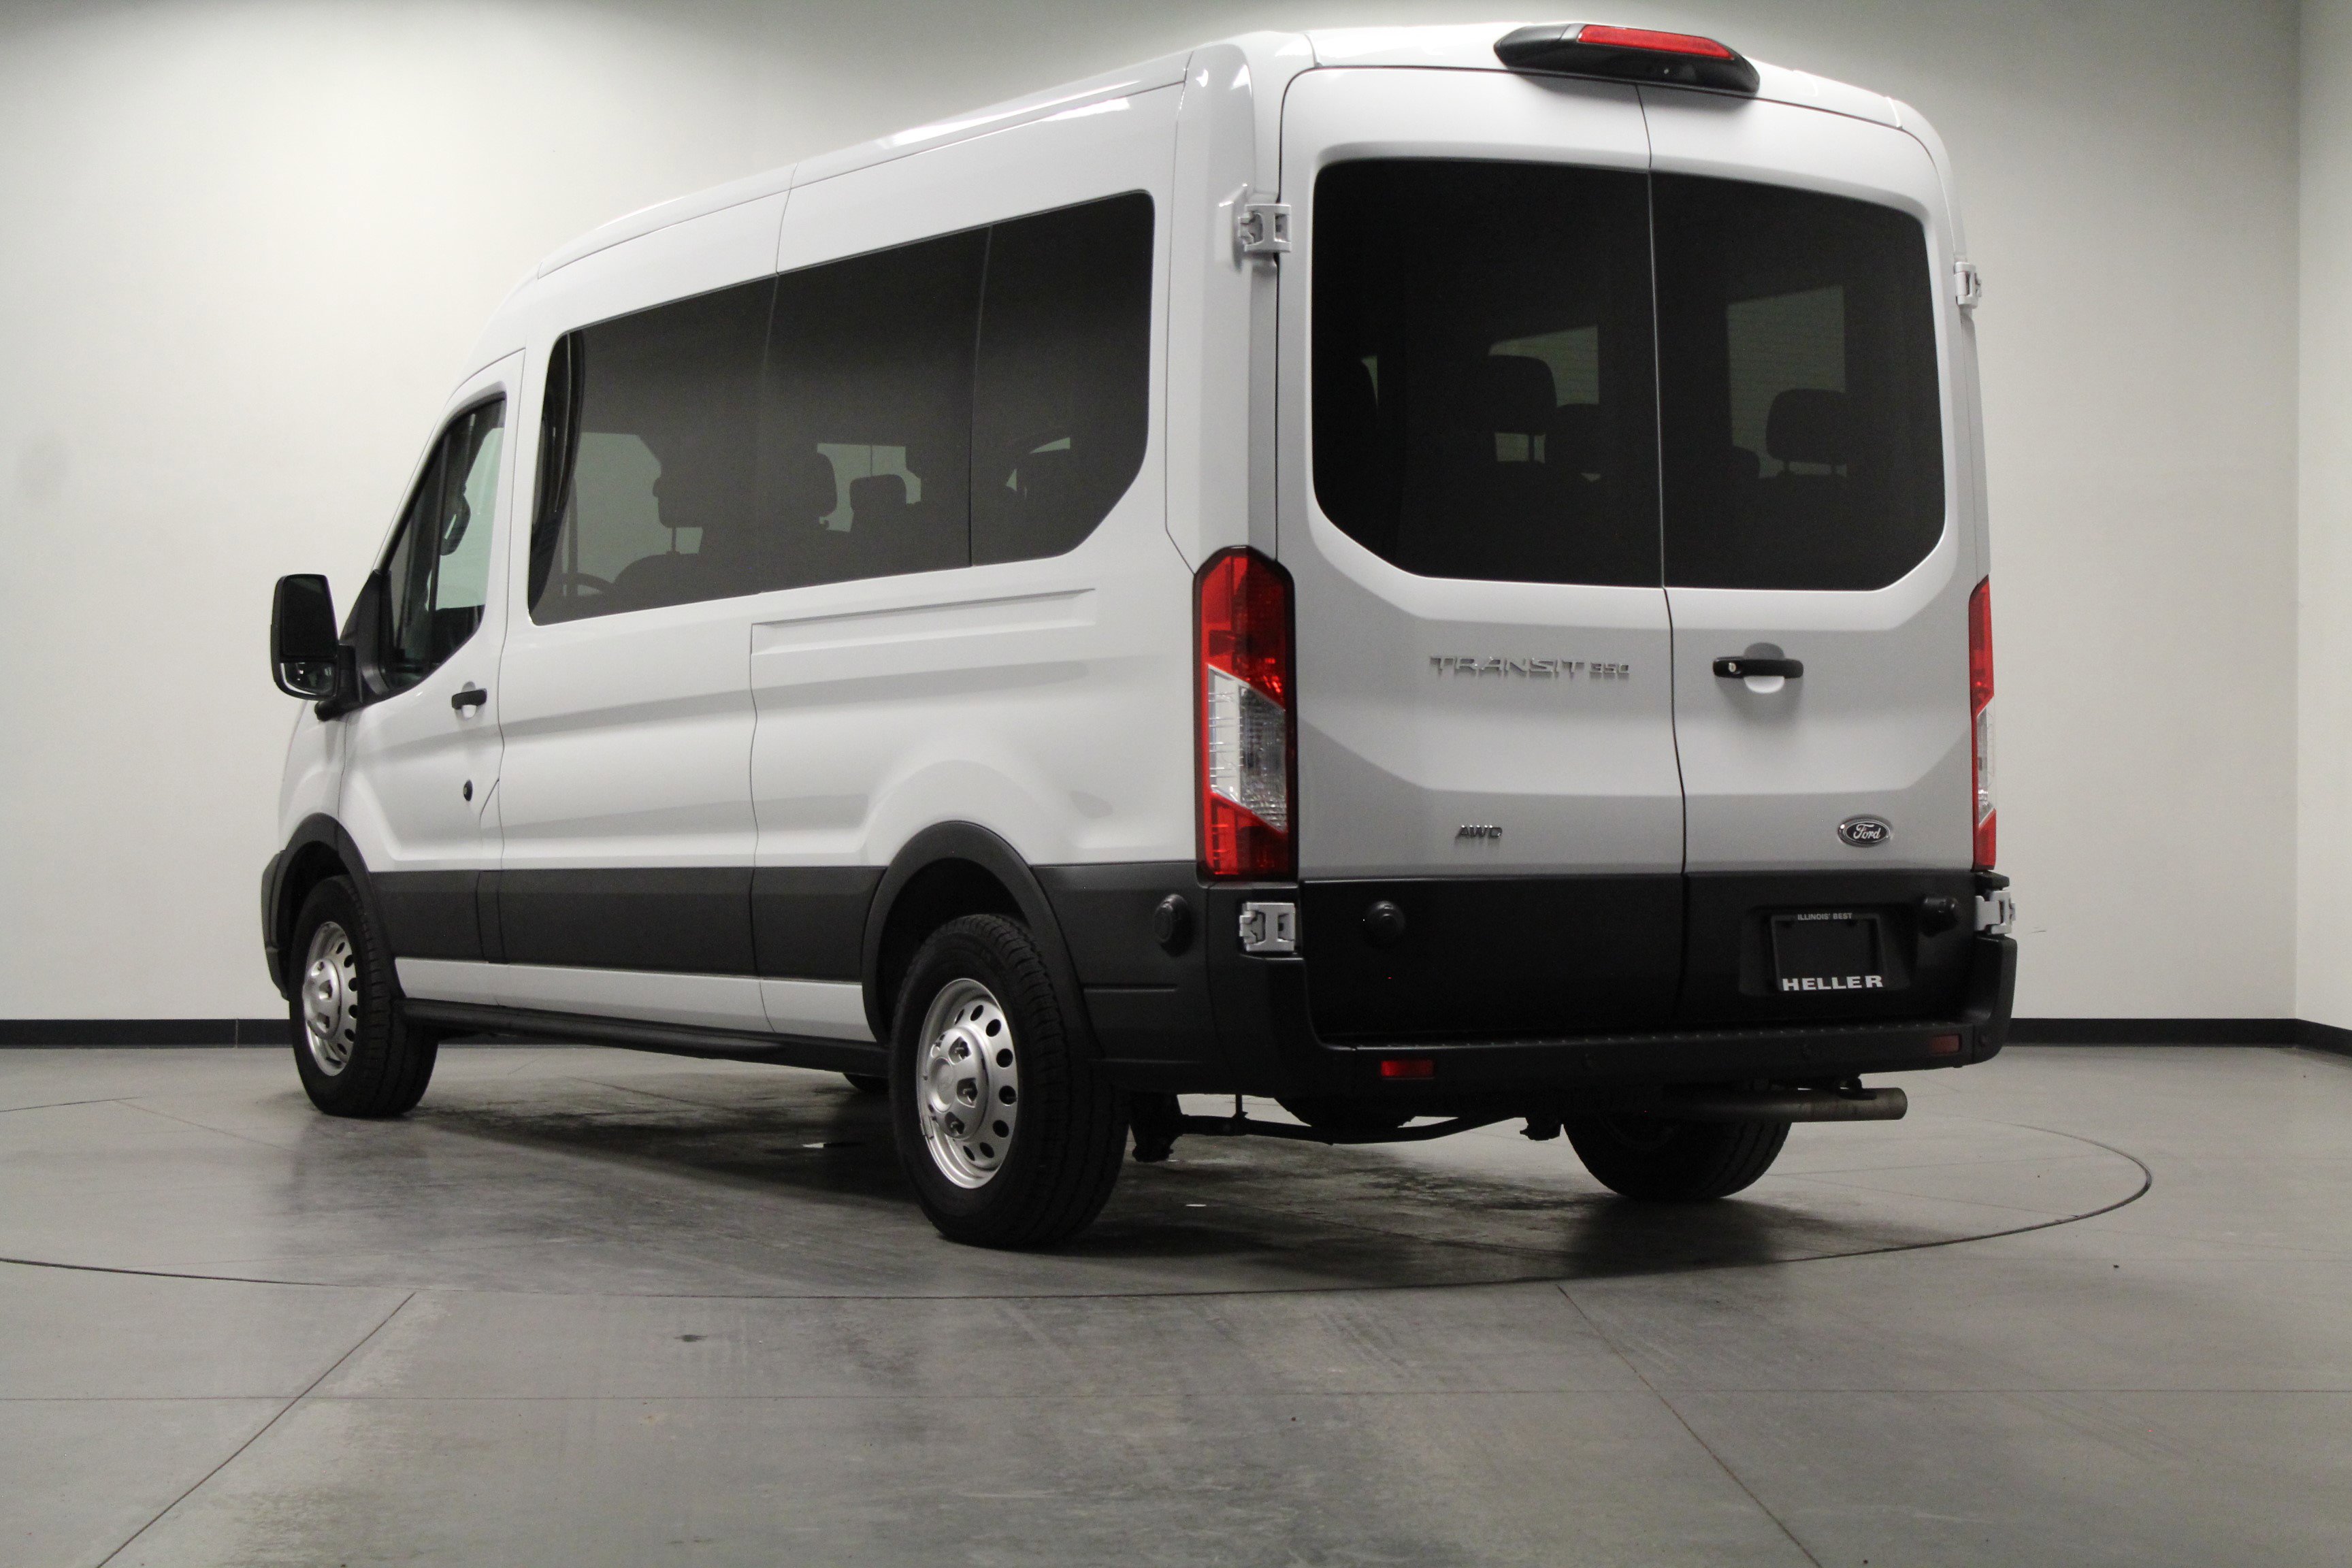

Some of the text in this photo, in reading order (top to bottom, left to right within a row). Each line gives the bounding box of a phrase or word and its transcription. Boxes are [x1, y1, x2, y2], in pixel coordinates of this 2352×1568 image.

[1429, 655, 1630, 678] TRANSIT 350
[1455, 824, 1503, 840] AWD
[1852, 823, 1882, 839] Ford
[1782, 975, 1884, 991] HELLER
